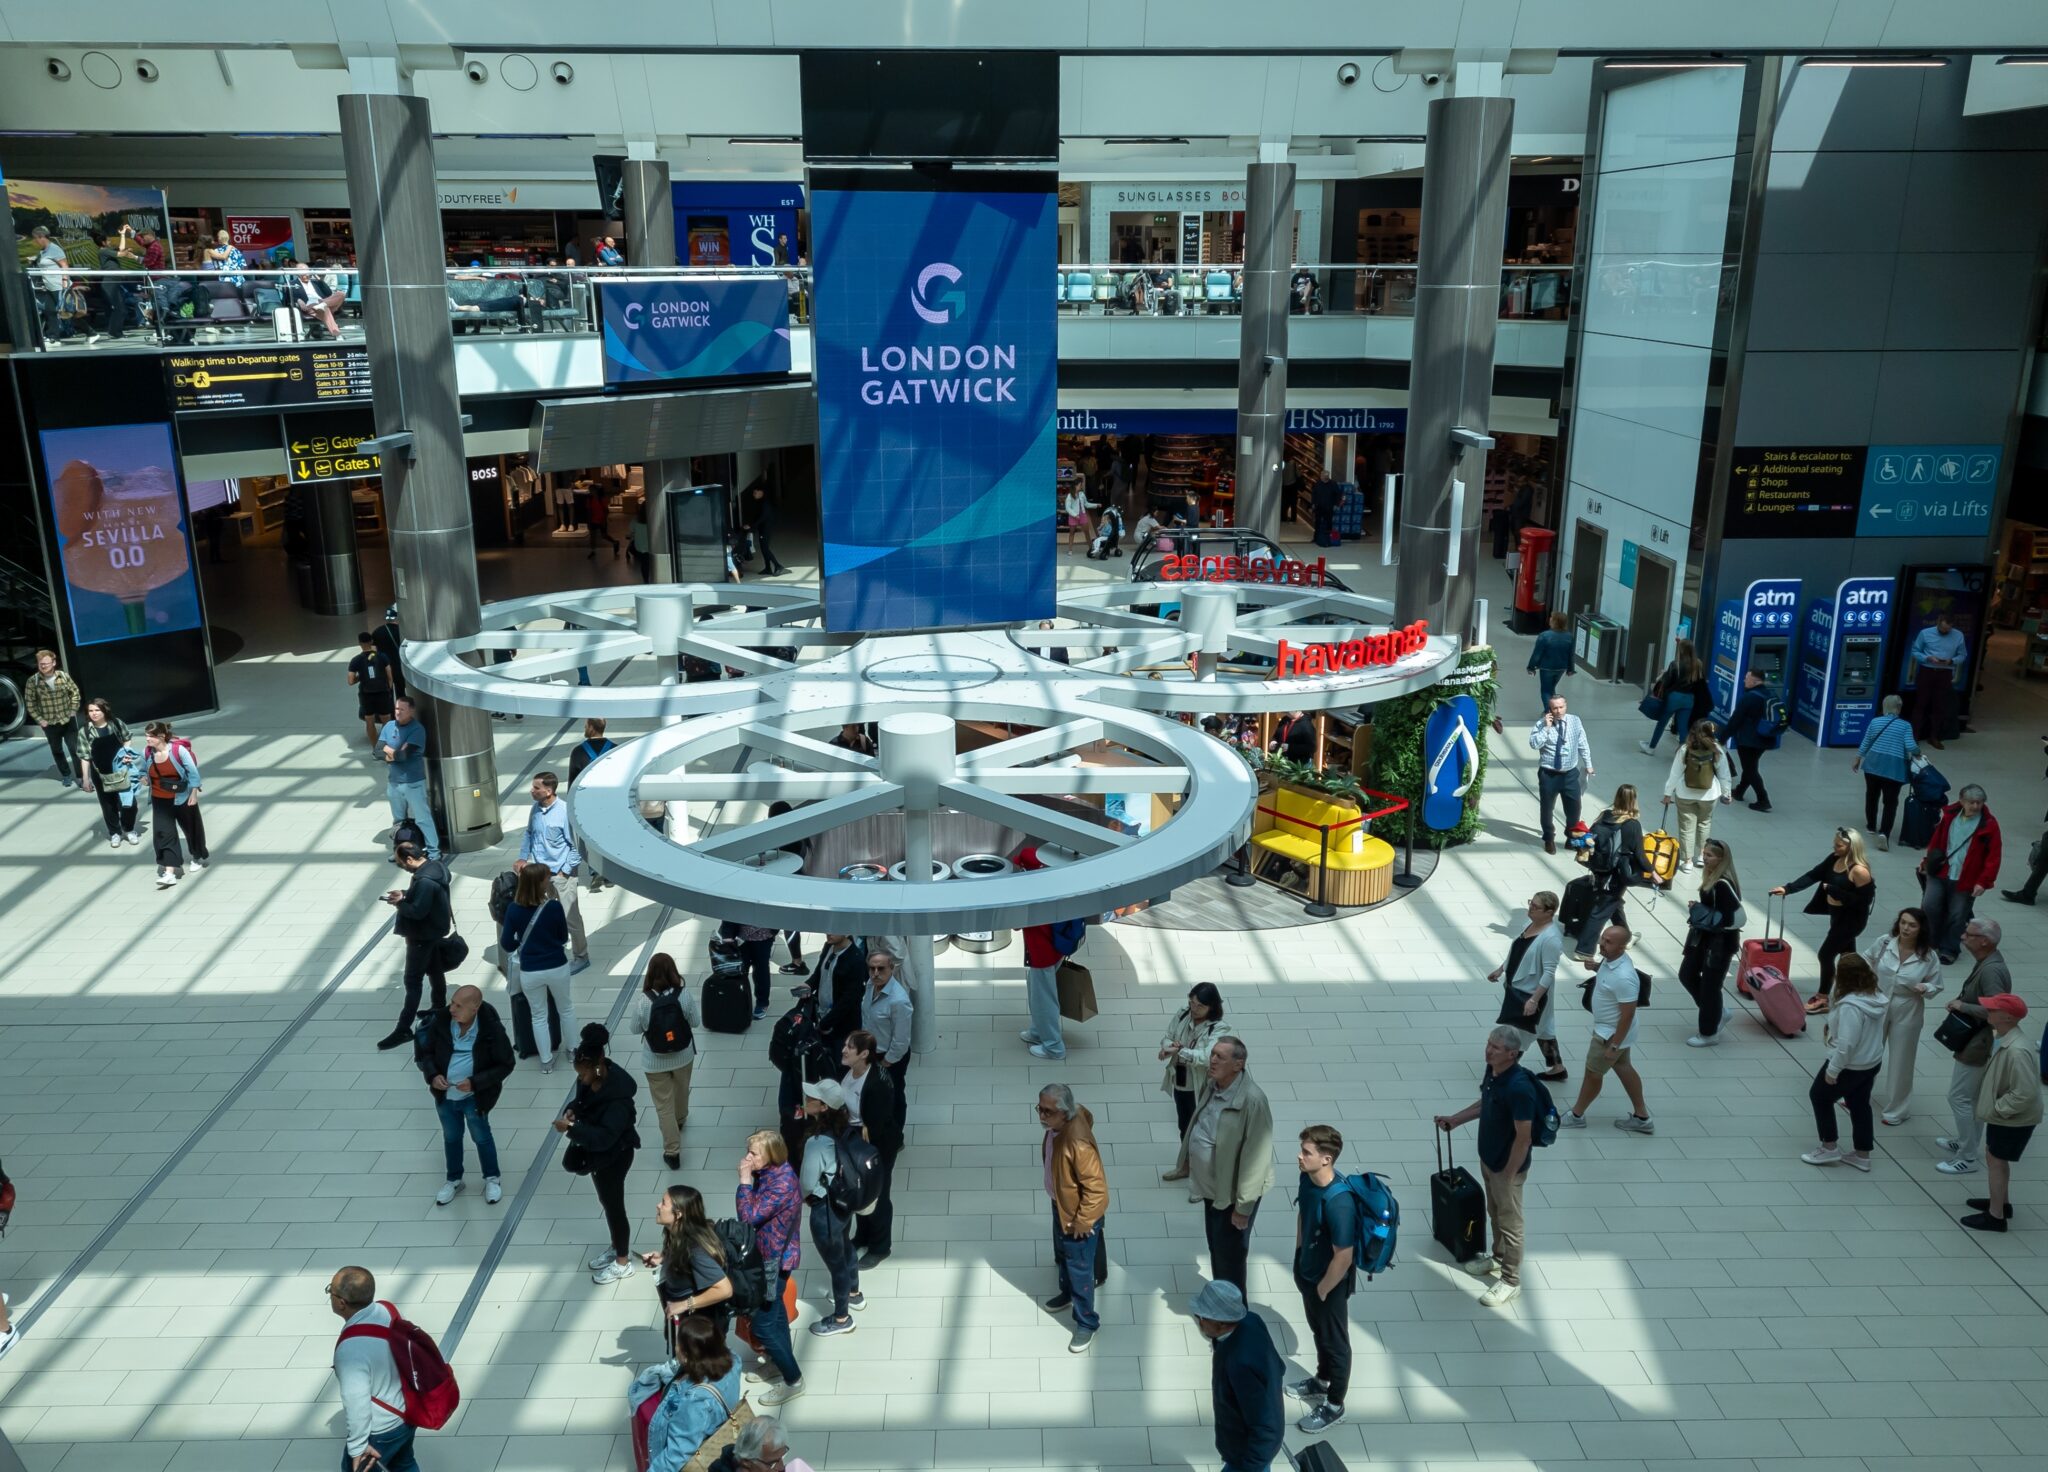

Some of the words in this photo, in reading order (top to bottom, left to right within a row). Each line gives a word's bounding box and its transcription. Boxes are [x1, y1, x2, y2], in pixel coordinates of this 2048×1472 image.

[1117, 191, 1211, 202] SUNGLASSES
[232, 223, 260, 235] 50%
[233, 235, 251, 243] Off
[698, 241, 720, 252] WIN
[651, 301, 710, 314] LONDON
[652, 315, 711, 328] GATWICK
[171, 358, 205, 368] Walking
[206, 356, 226, 366] time
[227, 356, 236, 365] to
[237, 355, 278, 365] Departure
[279, 354, 300, 364] gates
[861, 345, 1016, 372] LONDON
[861, 377, 1017, 406] GATWICK
[1285, 408, 1377, 429] HSmith
[1764, 452, 1789, 461] Stairs
[1790, 452, 1797, 460] &
[1798, 451, 1839, 460] escalator
[1840, 452, 1853, 460] to:
[335, 459, 370, 471] Gates
[1762, 464, 1809, 474] Additional
[1810, 464, 1843, 475] seating
[471, 467, 498, 481] BOSS
[1761, 477, 1788, 488] Shops
[1759, 490, 1810, 499] Restaurants
[83, 509, 120, 520] WITH
[127, 505, 156, 517] NEW
[1594, 501, 1602, 515] Lift
[1757, 503, 1795, 513] Lounges
[1923, 500, 1948, 517] via
[1952, 499, 1988, 517] Lifts
[82, 524, 165, 548] SEVILLA
[1659, 528, 1670, 545] Lift
[110, 545, 145, 569] 0.0
[1754, 589, 1796, 607] atm
[1846, 587, 1889, 605] atm
[1721, 609, 1741, 631] atm
[1811, 607, 1833, 629] atm
[1277, 619, 1429, 679] havaianas
